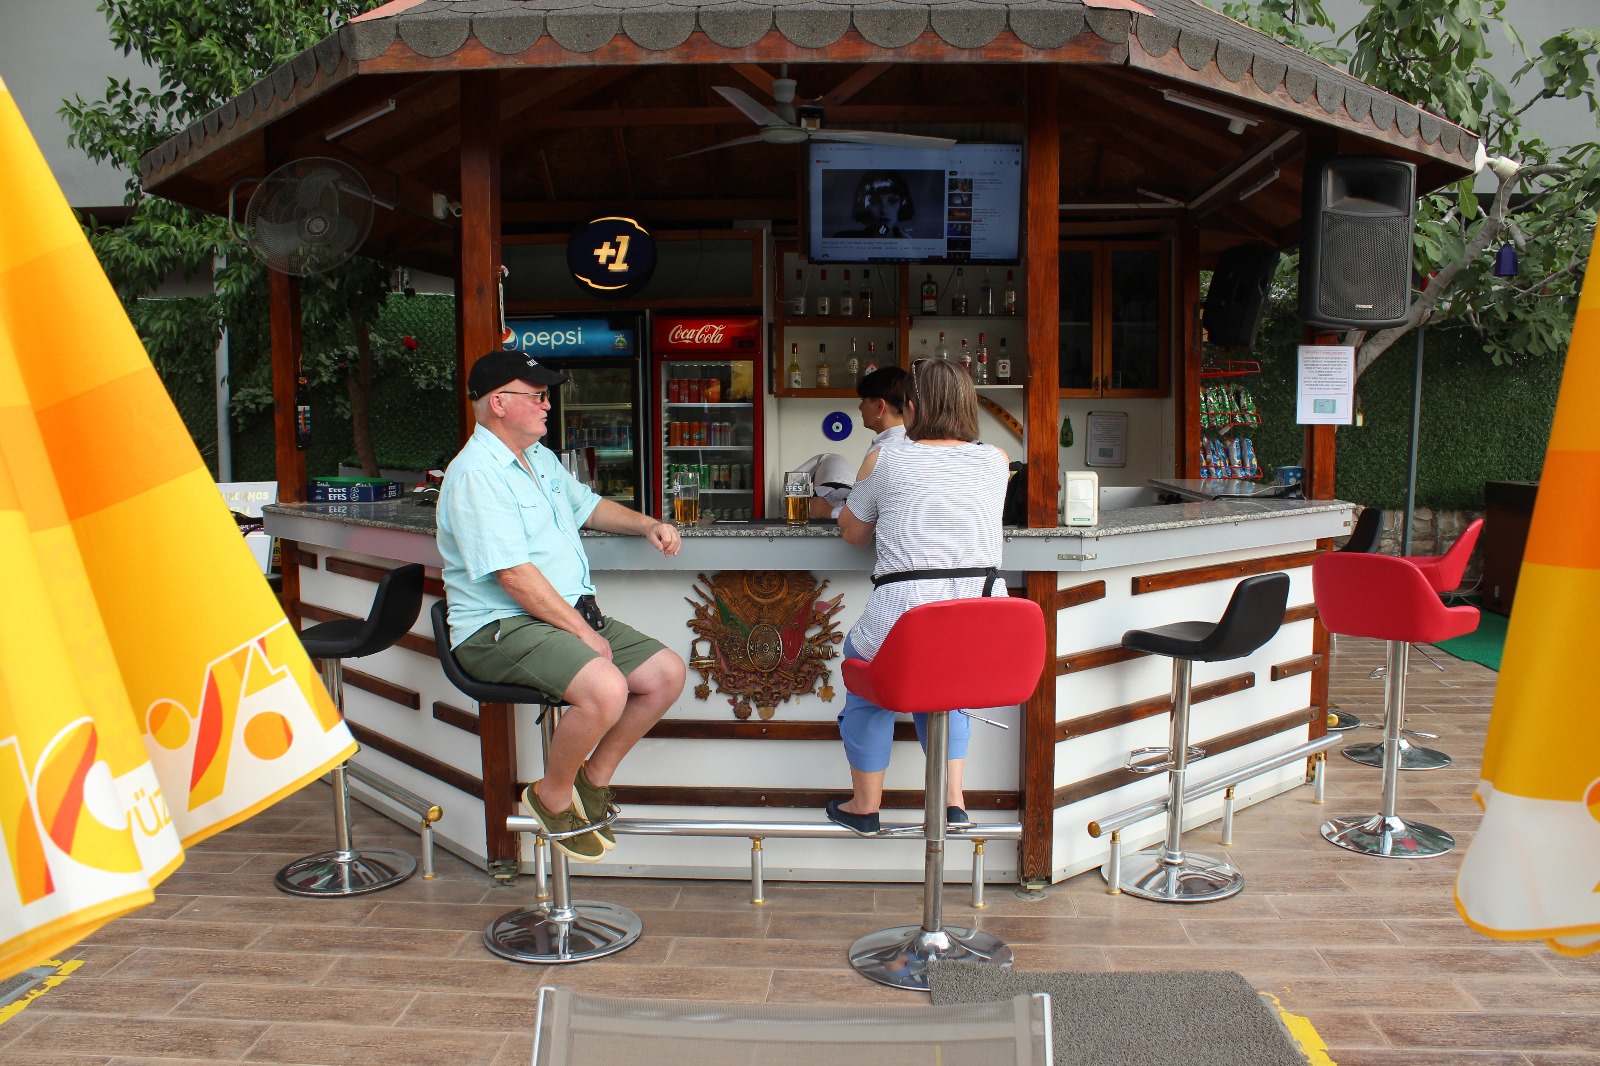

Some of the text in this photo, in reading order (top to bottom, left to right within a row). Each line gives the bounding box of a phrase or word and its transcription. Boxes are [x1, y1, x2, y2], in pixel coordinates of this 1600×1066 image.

[593, 235, 631, 272] +1
[522, 327, 582, 350] pepsi
[328, 493, 347, 501] EFES
